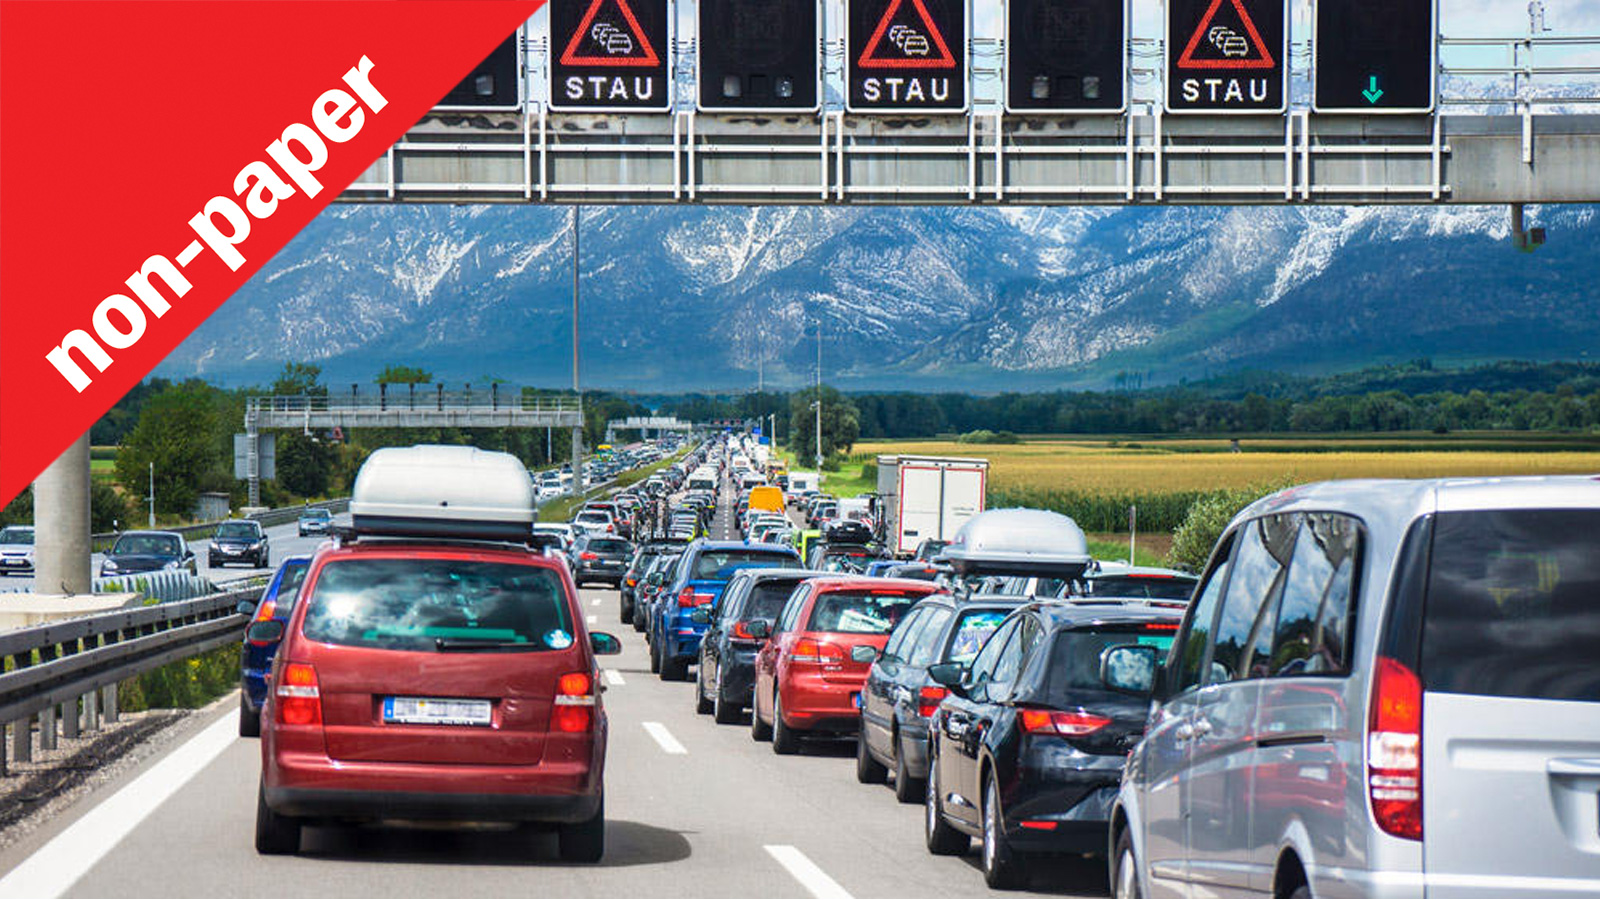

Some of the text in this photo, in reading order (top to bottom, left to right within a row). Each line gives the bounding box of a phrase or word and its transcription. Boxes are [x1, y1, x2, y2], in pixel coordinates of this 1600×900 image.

[566, 76, 653, 99] STAU
[863, 77, 950, 102] STAU
[1183, 78, 1268, 102] STAU
